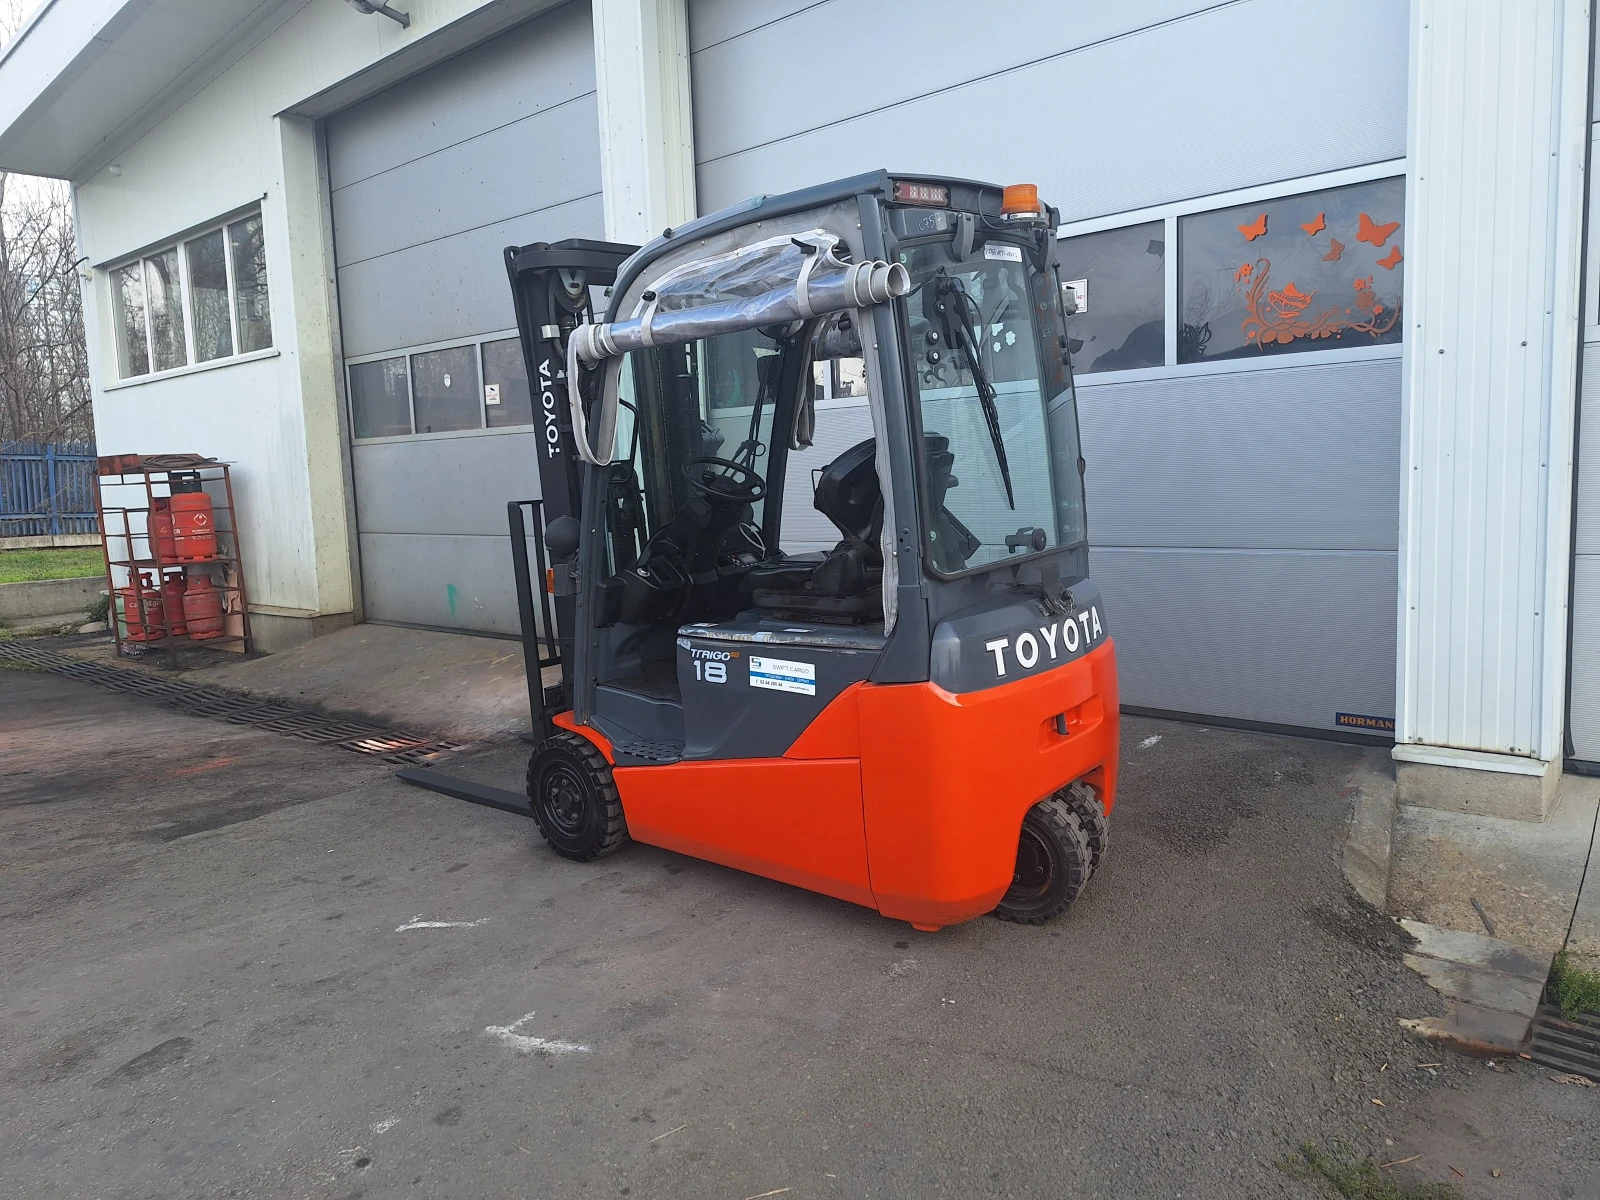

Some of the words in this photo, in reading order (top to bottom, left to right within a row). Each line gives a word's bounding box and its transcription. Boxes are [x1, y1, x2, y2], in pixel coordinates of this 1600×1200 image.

[538, 358, 560, 459] TOYOTA
[985, 605, 1103, 676] TOYOTA
[693, 660, 727, 684] 18
[772, 663, 789, 671] SWIFT
[789, 666, 810, 674] CARGO
